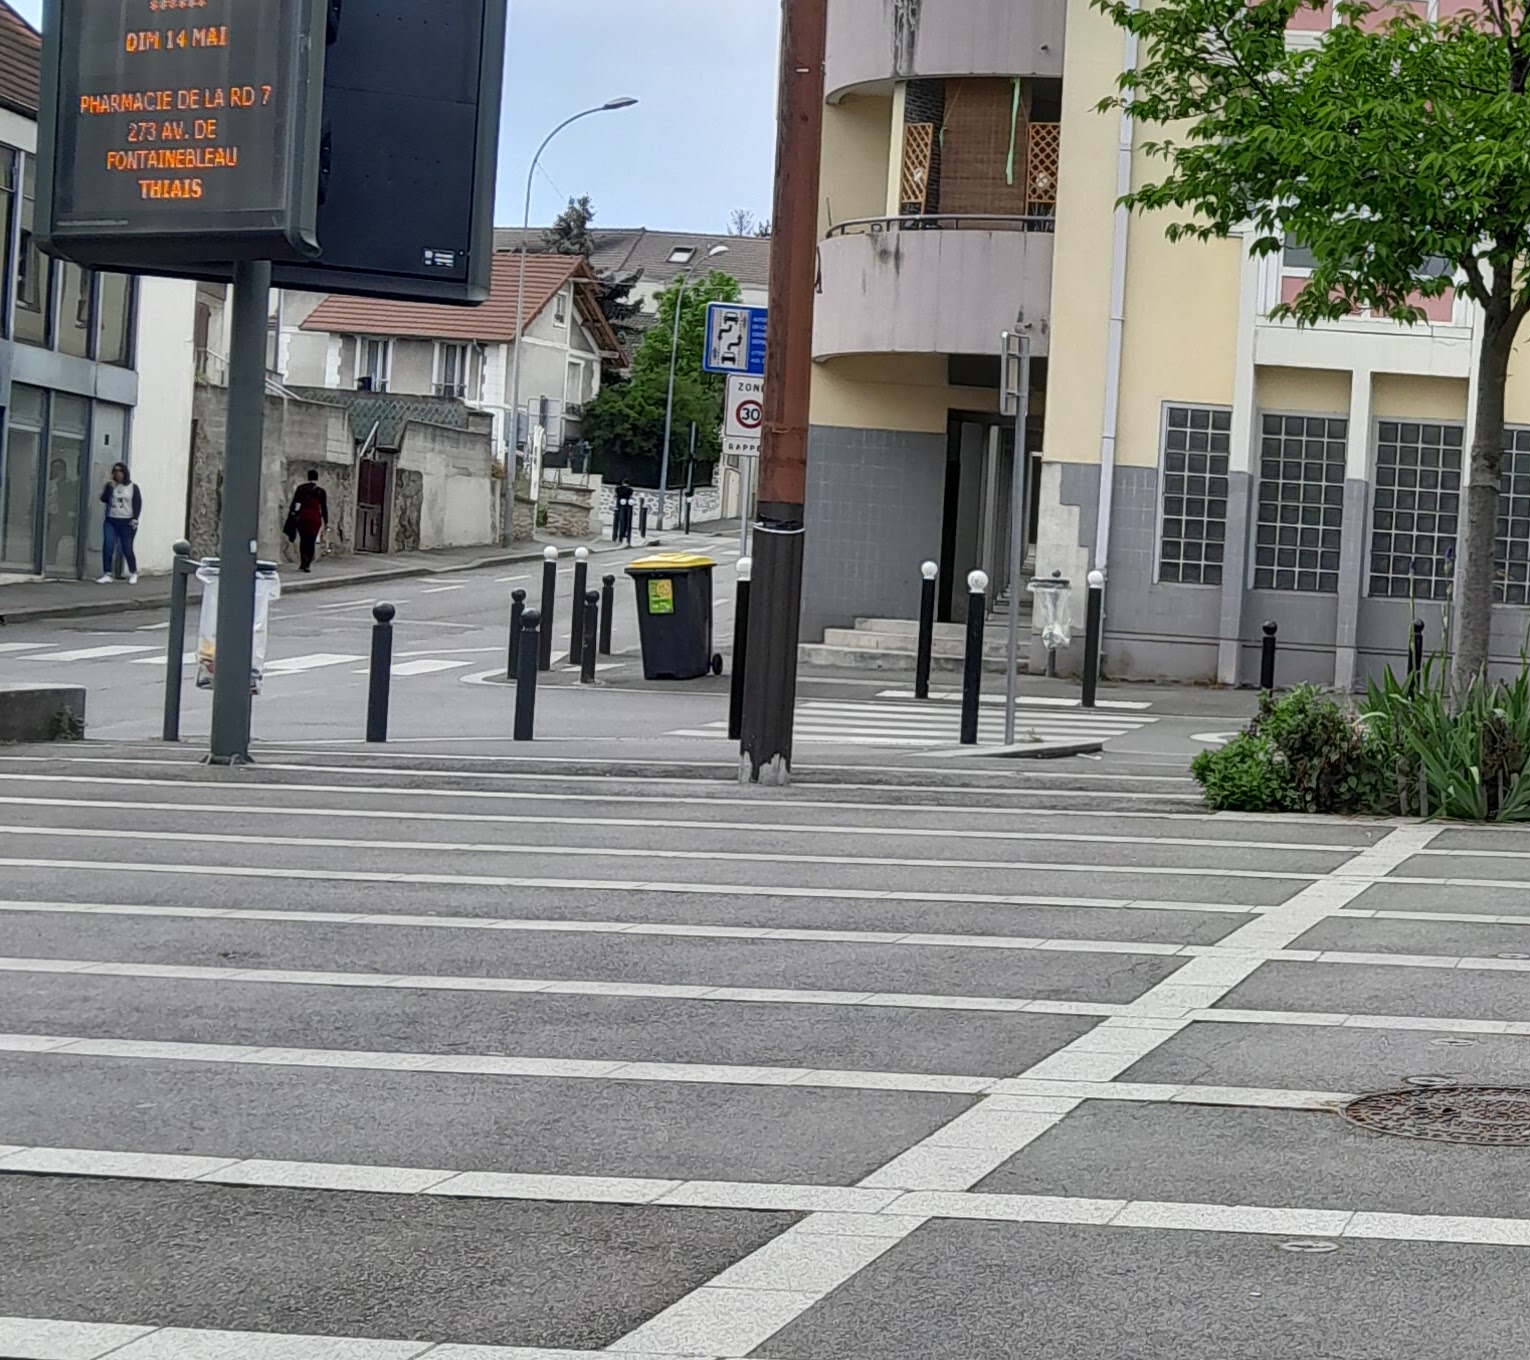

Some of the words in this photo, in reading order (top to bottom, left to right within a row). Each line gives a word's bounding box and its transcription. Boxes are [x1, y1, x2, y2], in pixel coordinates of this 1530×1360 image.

[125, 30, 160, 53] DIM
[166, 29, 187, 50] 14
[192, 26, 228, 48] MAI
[79, 90, 174, 114] PHARMACIE
[177, 89, 200, 110] DE
[204, 88, 225, 108] LA
[230, 86, 255, 108] RD
[261, 85, 272, 106] 7
[127, 122, 157, 142] 273
[161, 121, 190, 141] AV.
[194, 119, 217, 140] DE
[107, 146, 238, 171] FONTAINEBLEAU
[137, 178, 203, 199] THIAIS
[741, 407, 761, 422] 30
[728, 443, 760, 453] RAPPE
